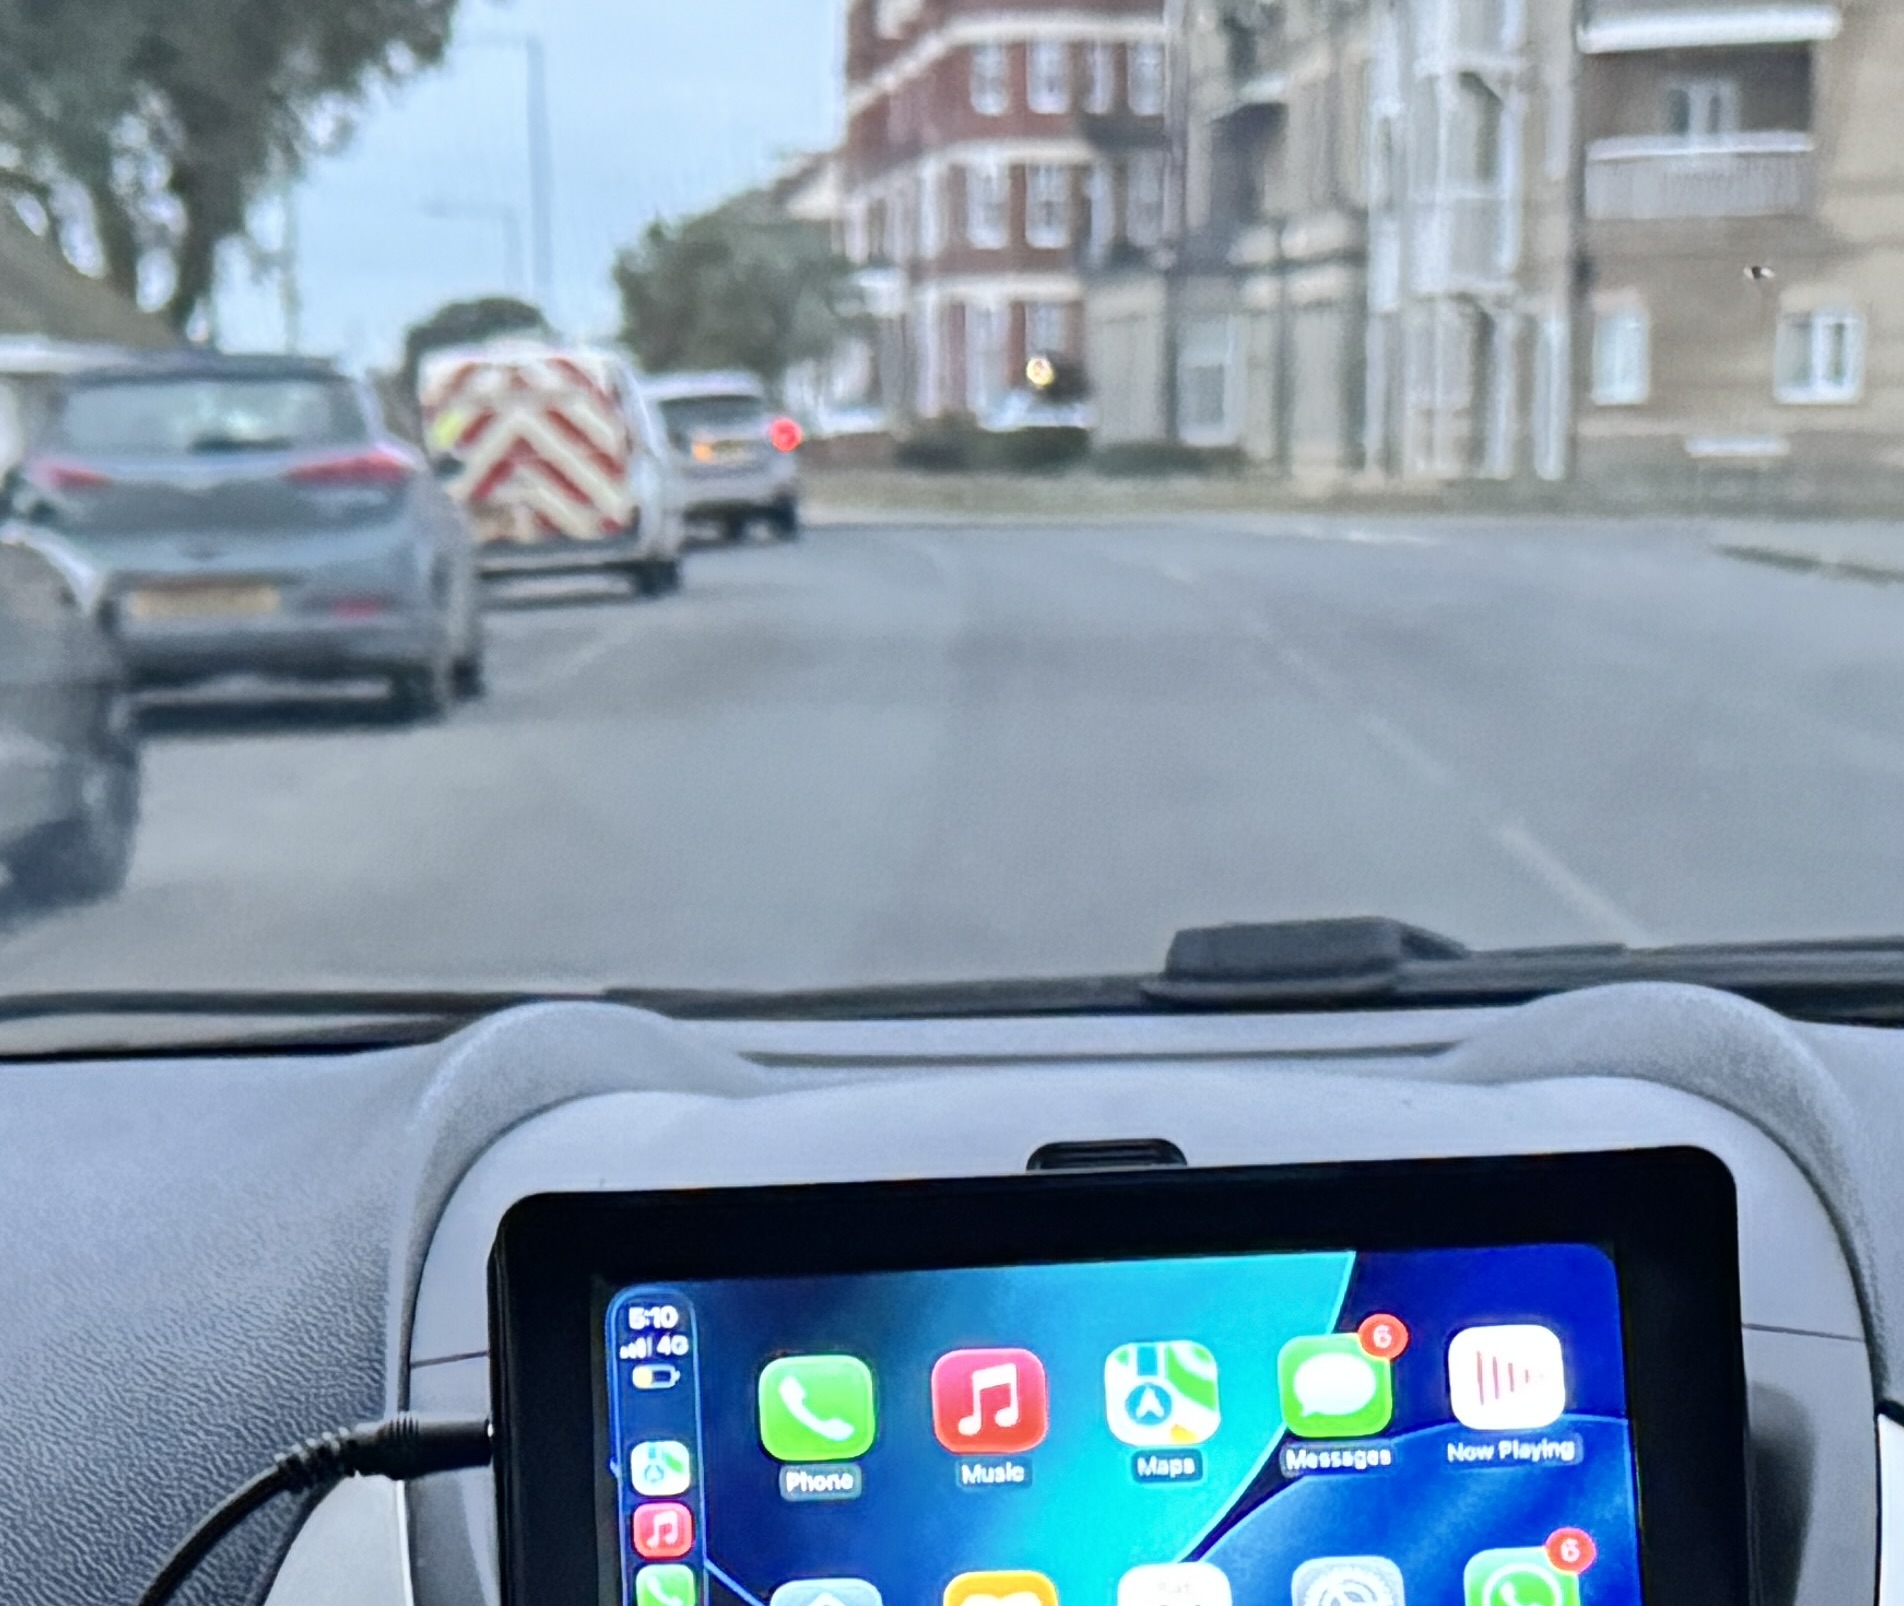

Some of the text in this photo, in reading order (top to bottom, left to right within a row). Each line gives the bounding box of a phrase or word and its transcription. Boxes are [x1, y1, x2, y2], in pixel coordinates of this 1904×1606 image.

[629, 1306, 679, 1330] 5:10
[1372, 1324, 1393, 1349] 6
[1285, 1448, 1392, 1471] Messages
[1447, 1438, 1575, 1463] Now Playing
[961, 1460, 1025, 1485] Music
[1136, 1455, 1195, 1478] Maps
[786, 1469, 854, 1493] Phone
[1560, 1538, 1581, 1563] 6
